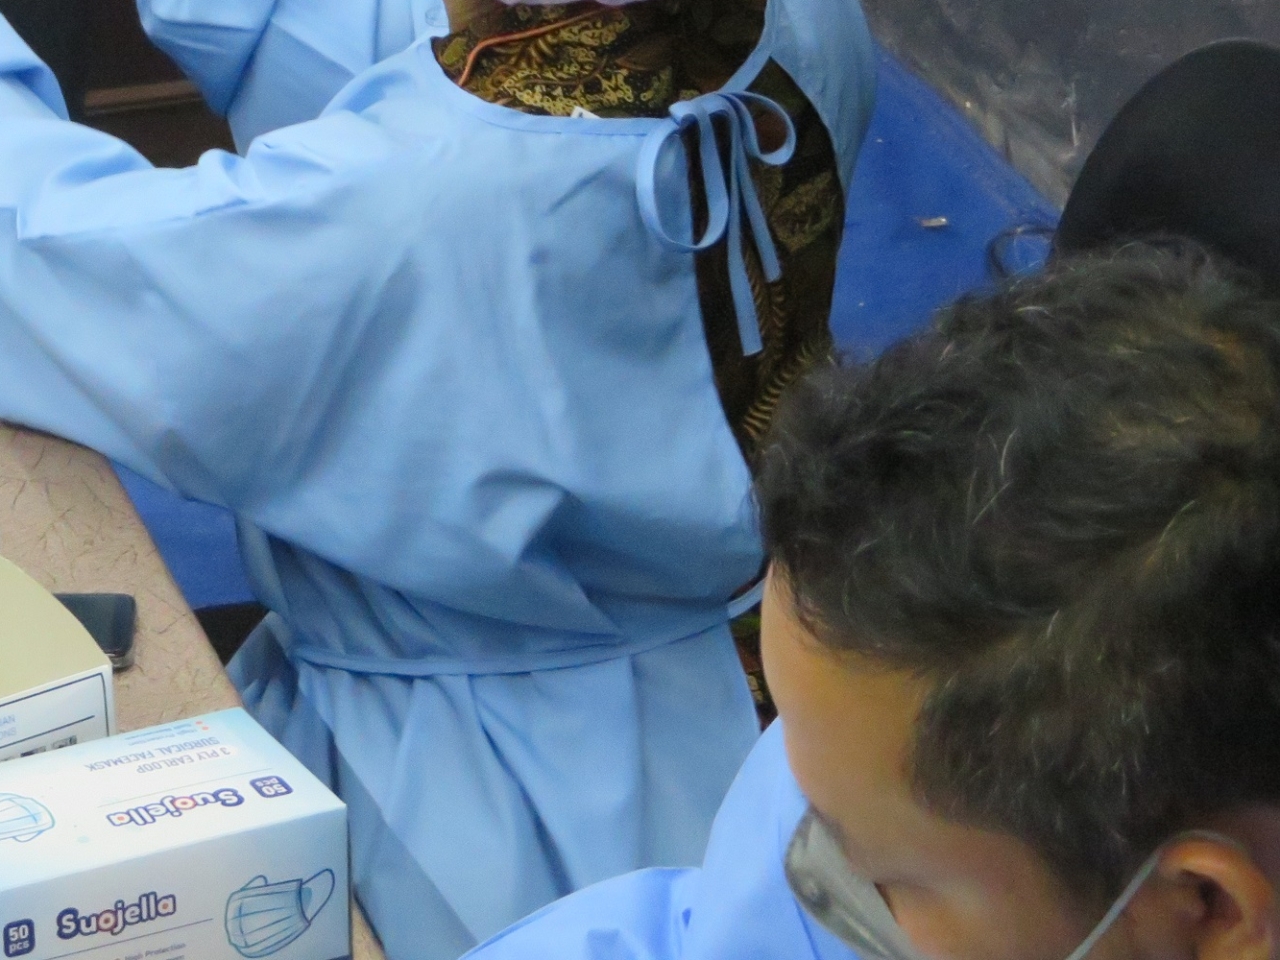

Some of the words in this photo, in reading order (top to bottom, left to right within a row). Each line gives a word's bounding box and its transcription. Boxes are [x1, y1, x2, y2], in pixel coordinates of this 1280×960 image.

[157, 736, 220, 756] SURGICAL
[197, 748, 223, 762] PLY
[84, 750, 155, 772] FACEMASK
[136, 754, 195, 774] EARLOOP
[261, 785, 286, 797] 50
[106, 788, 245, 827] Suojella
[56, 891, 176, 939] Suojella
[9, 924, 29, 941] 50
[8, 940, 31, 954] pcs
